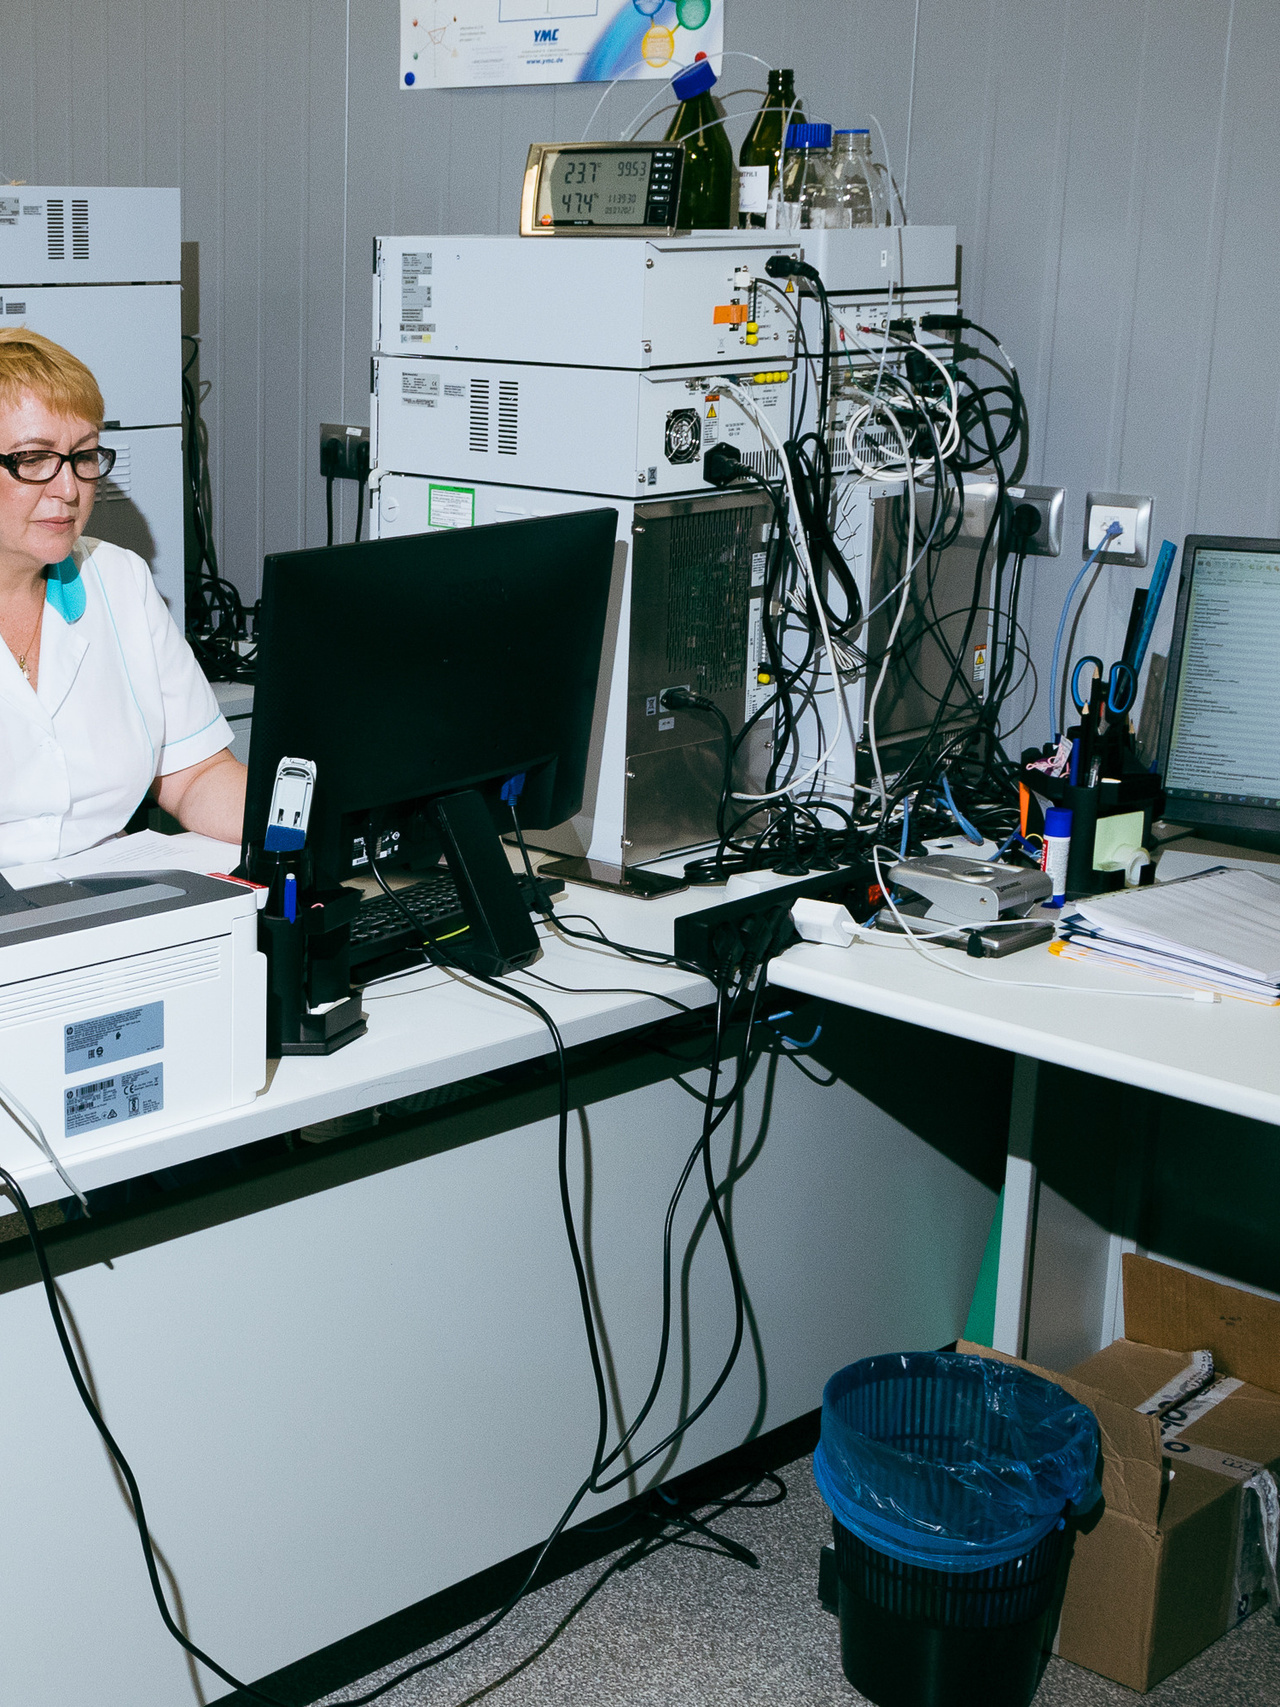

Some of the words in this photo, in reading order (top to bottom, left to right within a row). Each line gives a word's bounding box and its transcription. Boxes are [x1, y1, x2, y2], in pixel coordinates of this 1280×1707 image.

[534, 28, 560, 42] YMC
[564, 161, 597, 184] 23.7
[562, 192, 594, 214] 47.4
